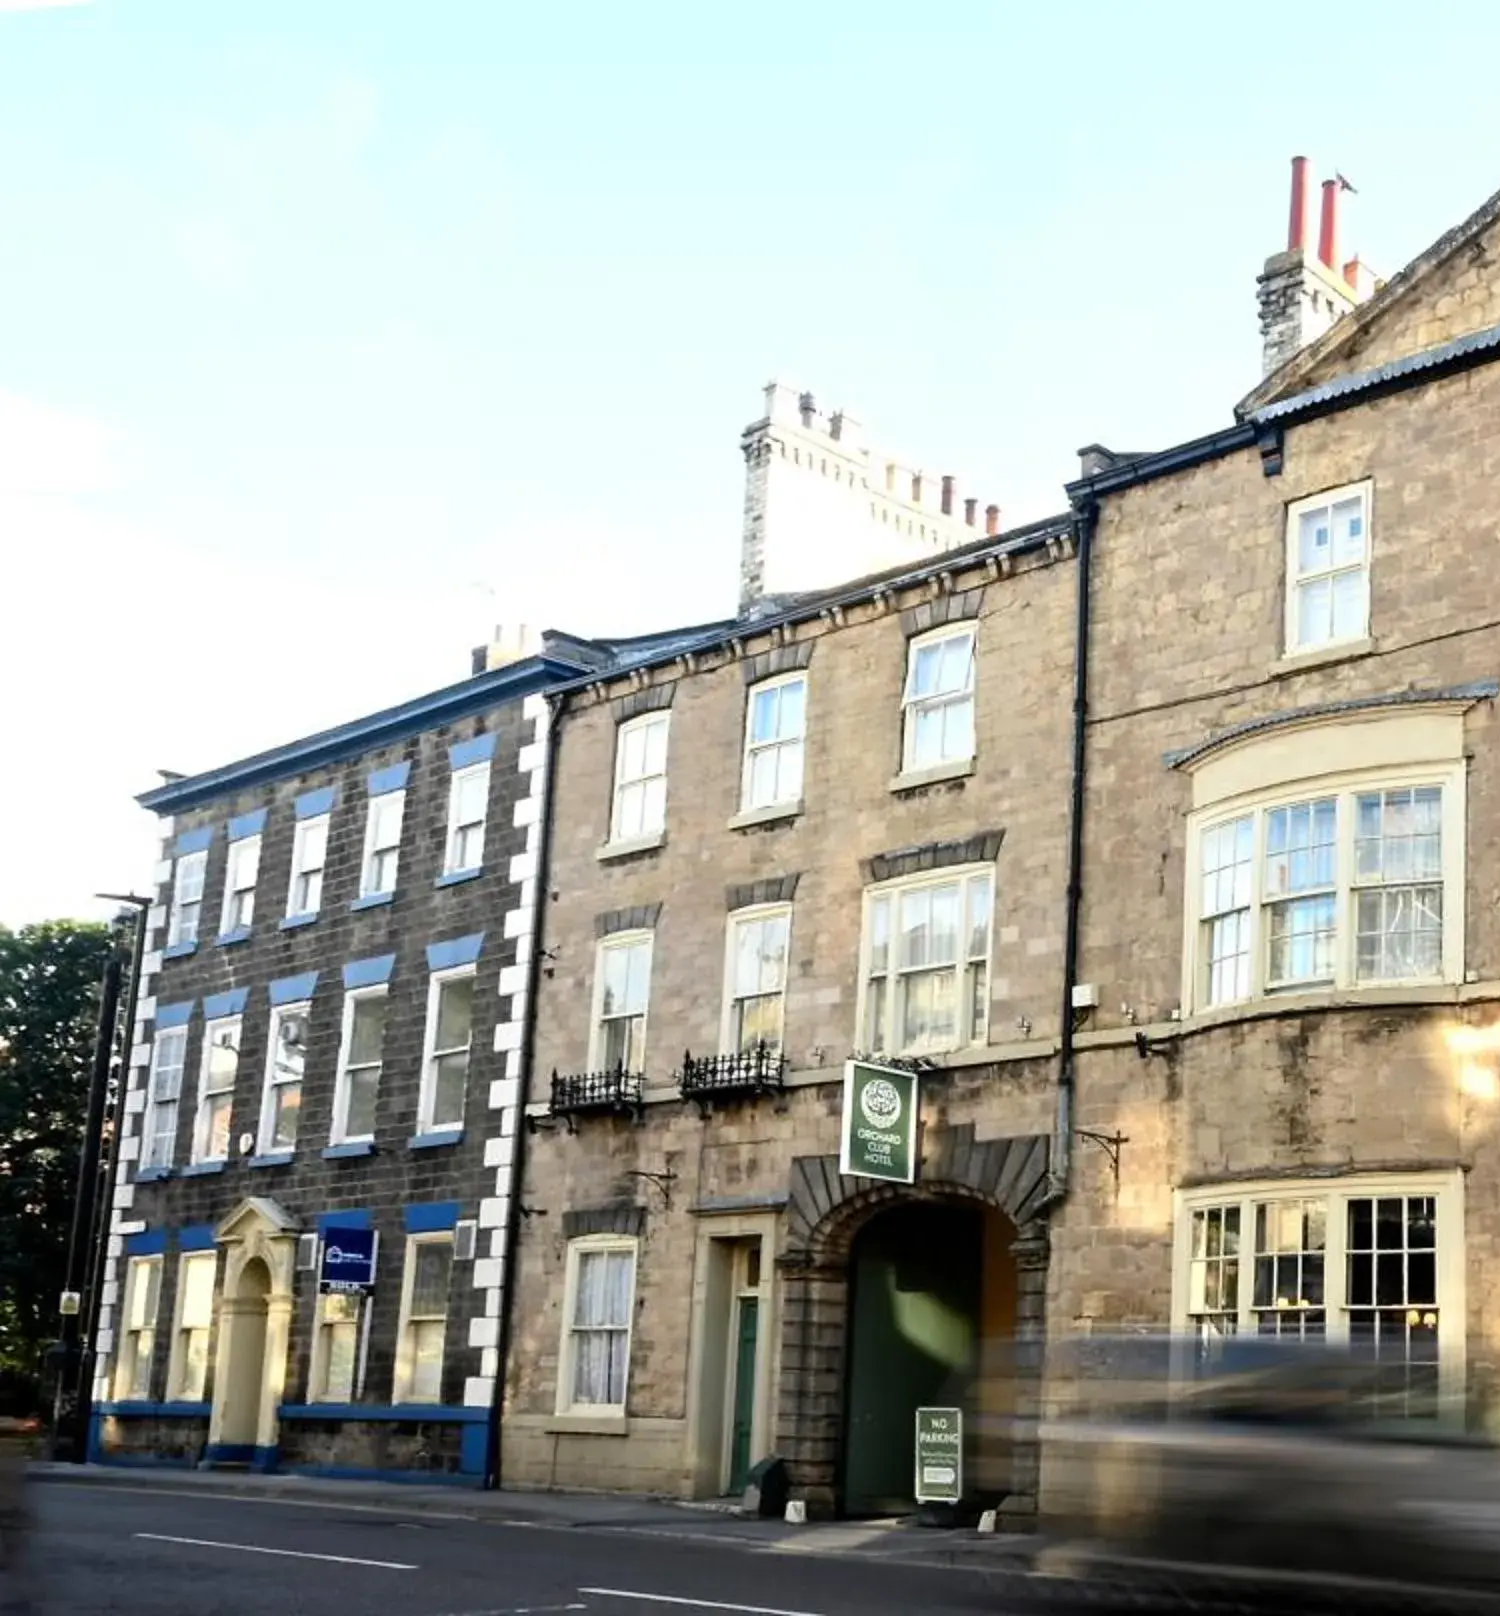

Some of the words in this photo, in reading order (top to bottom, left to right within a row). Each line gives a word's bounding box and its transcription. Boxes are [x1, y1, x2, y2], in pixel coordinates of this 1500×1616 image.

[857, 1128, 902, 1145] ORCHARD
[867, 1141, 891, 1155] CLUB
[864, 1153, 893, 1167] HOTEL
[931, 1418, 948, 1429] NO
[920, 1432, 960, 1445] PARKING
